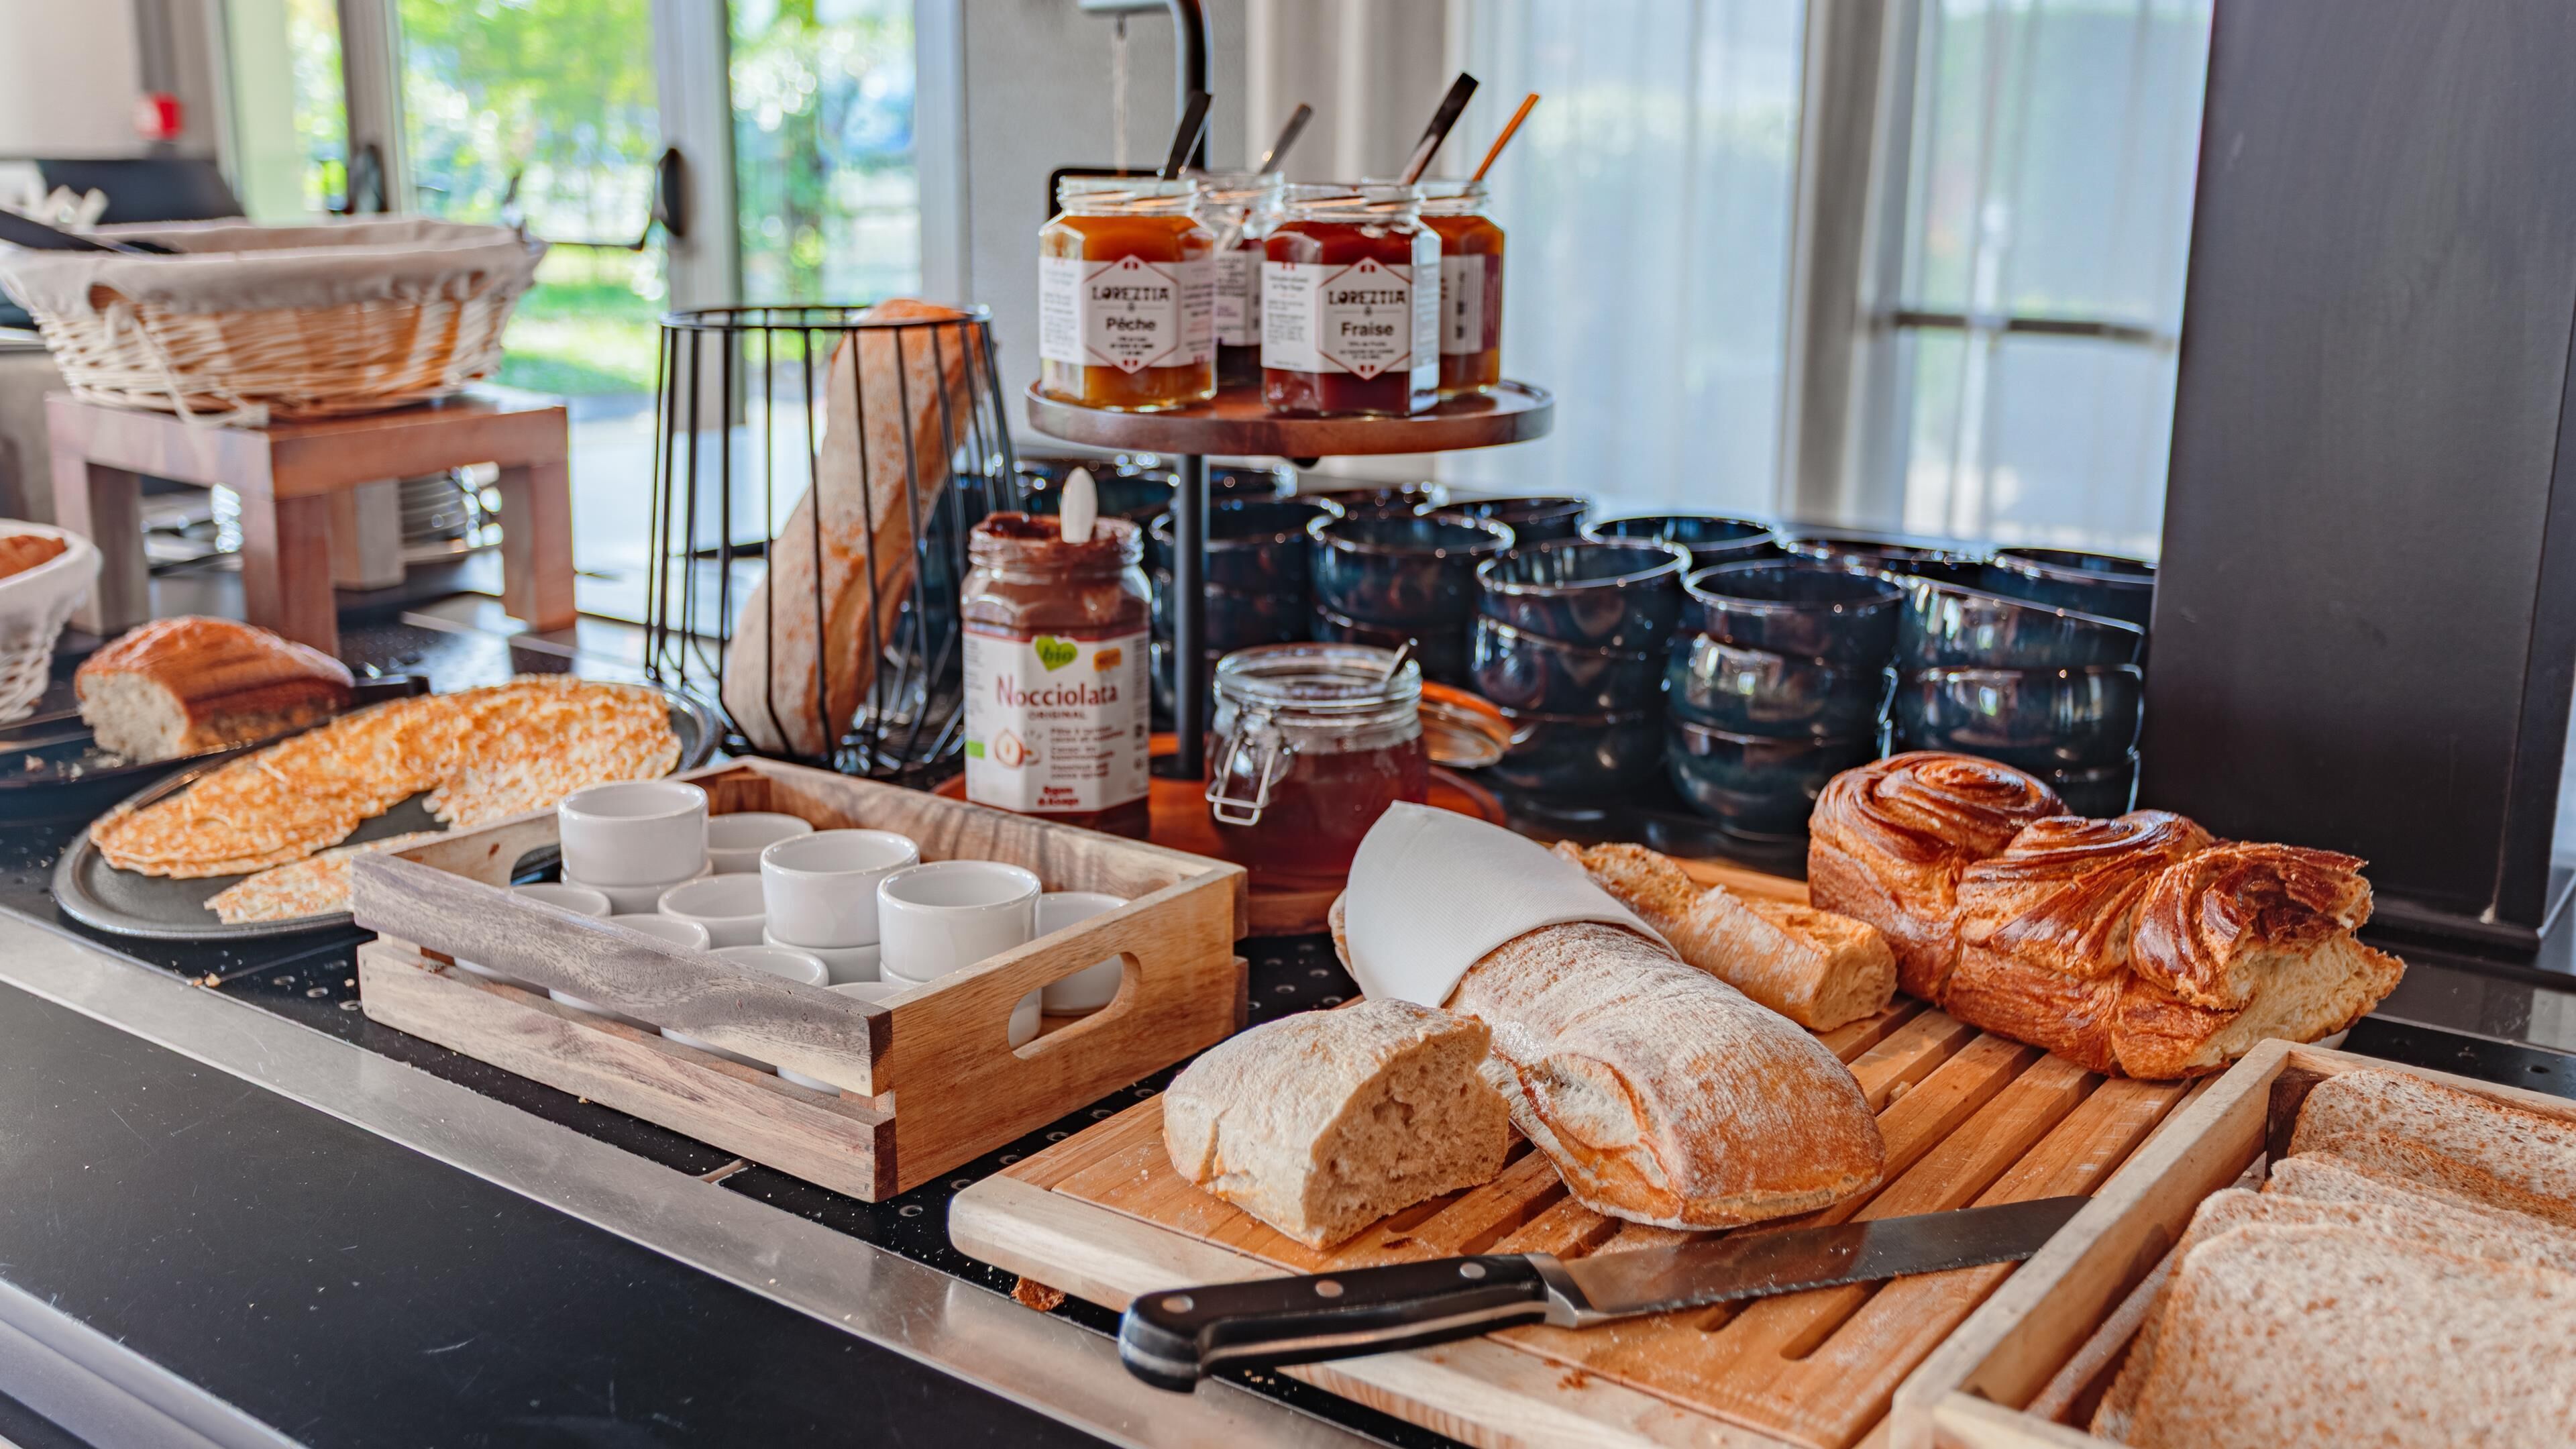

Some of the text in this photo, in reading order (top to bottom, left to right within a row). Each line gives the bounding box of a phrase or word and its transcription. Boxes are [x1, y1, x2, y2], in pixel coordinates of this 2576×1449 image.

[1092, 286, 1169, 300] LOREZTIA
[1328, 290, 1406, 305] LOREZTIA
[1106, 317, 1156, 331] Pêche
[1341, 322, 1394, 336] Fraise
[1042, 646, 1073, 661] bio
[996, 674, 1118, 708] Nocciolata
